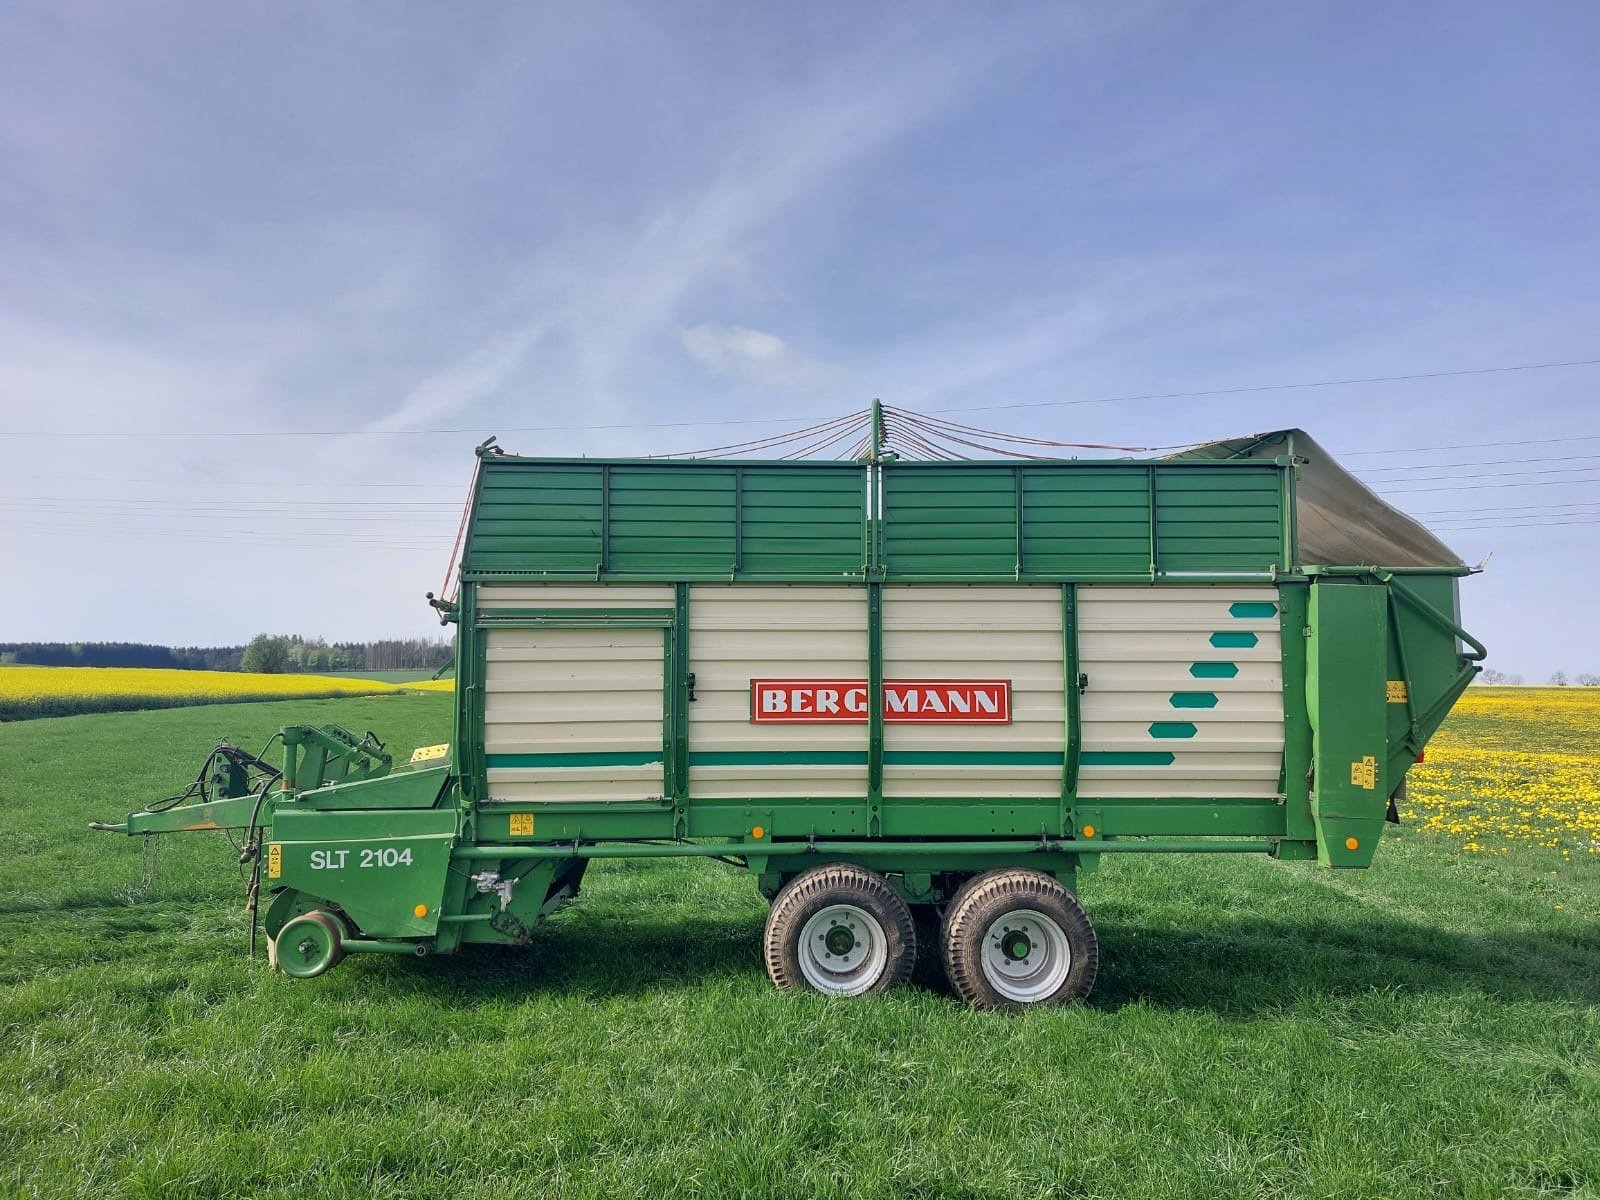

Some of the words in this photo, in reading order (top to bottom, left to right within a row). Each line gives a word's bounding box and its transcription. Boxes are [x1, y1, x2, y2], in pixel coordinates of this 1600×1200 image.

[762, 688, 998, 714] BERGMANN
[310, 850, 349, 870] SLT
[359, 848, 413, 868] 2104
